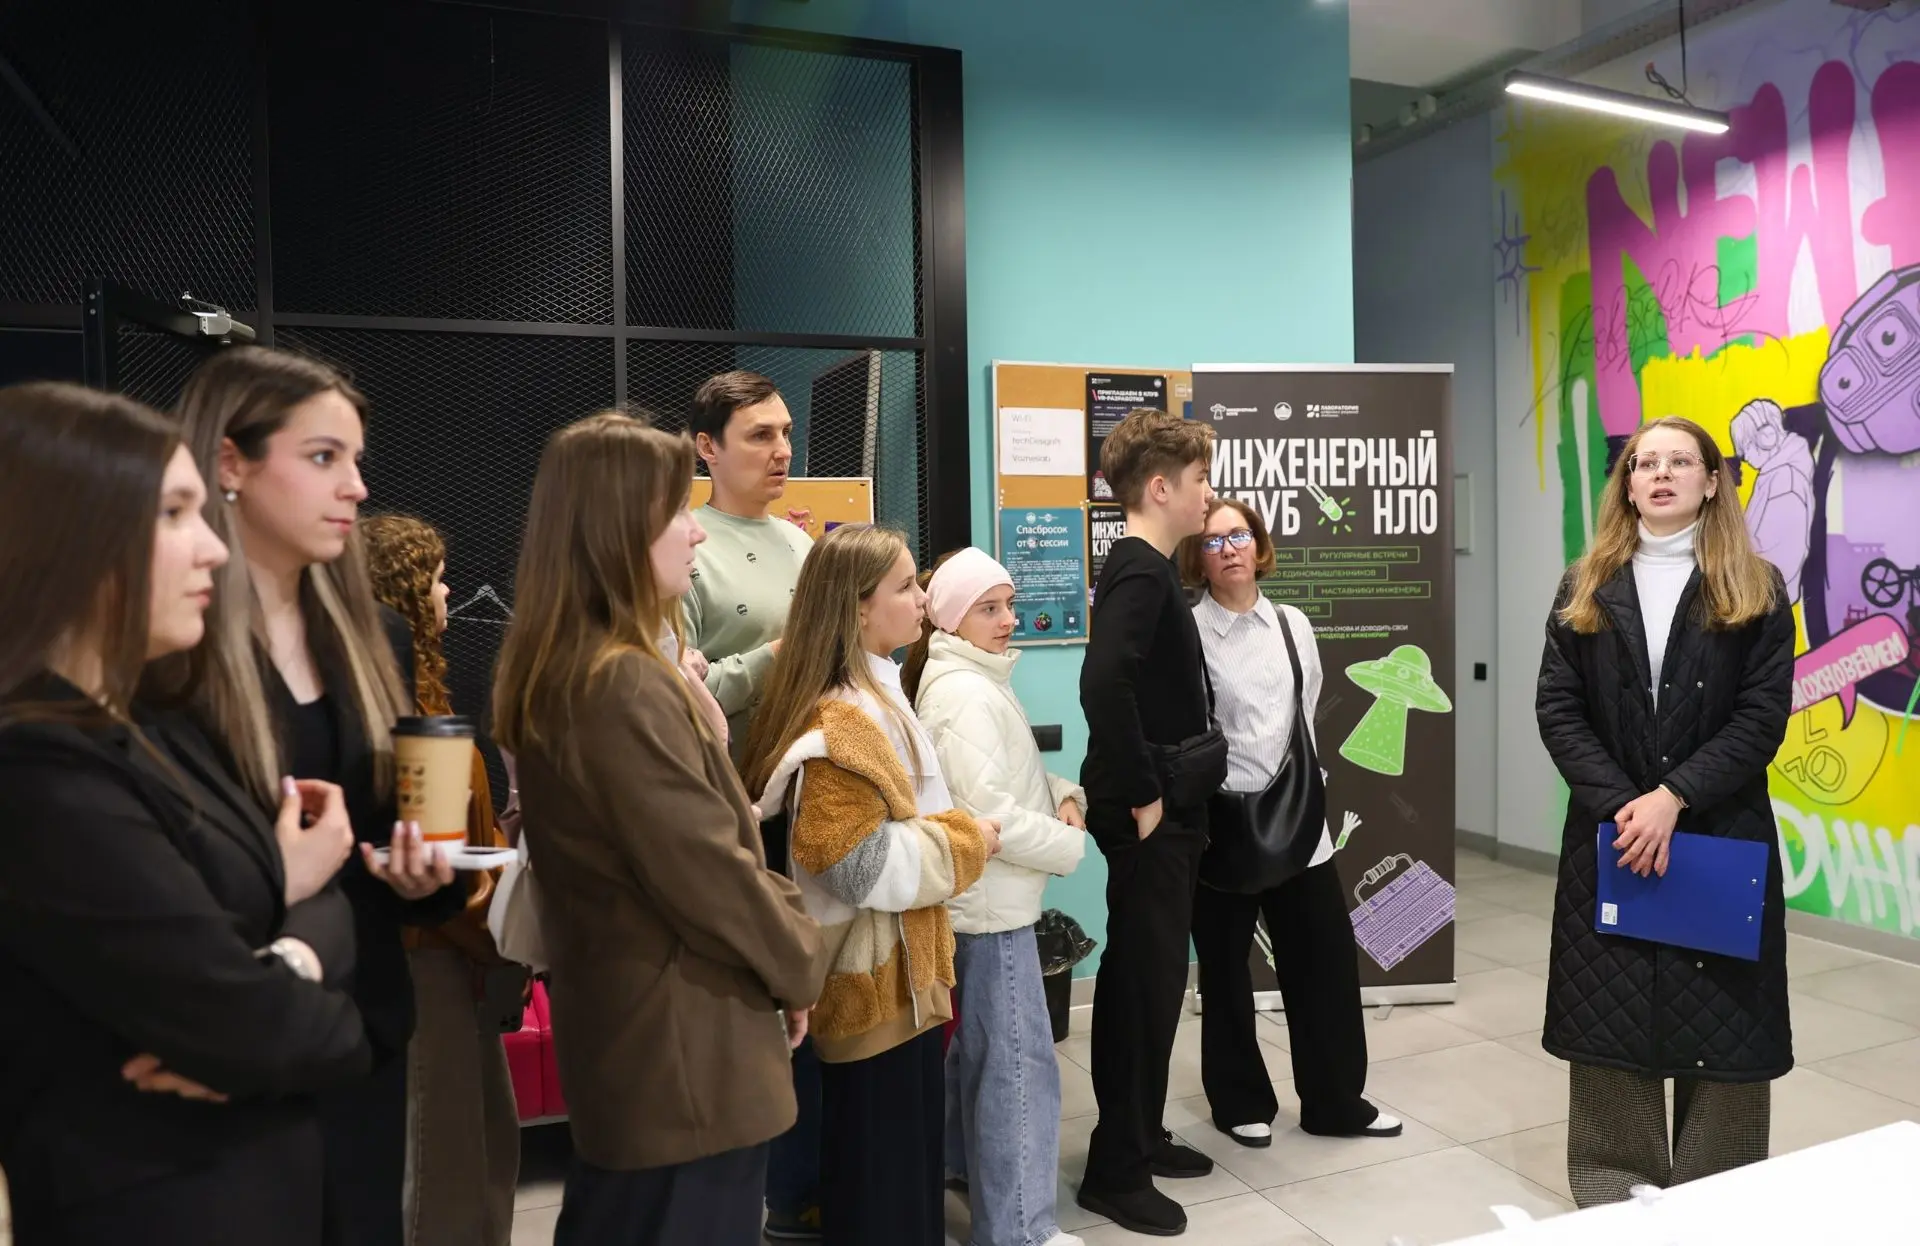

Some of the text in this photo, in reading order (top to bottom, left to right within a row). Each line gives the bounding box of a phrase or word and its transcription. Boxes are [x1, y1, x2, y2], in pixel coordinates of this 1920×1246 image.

[1211, 430, 1438, 488] ИНЖЕНЕРНЫЙ
[1214, 488, 1438, 536] УБ НЛО
[1016, 525, 1068, 536] Спасбросок
[1040, 539, 1069, 547] сессии
[1373, 551, 1408, 559] ВСТРЕЧИ
[1282, 569, 1376, 579] ЕДИНОМЫШЛЕННИКОВ
[1321, 586, 1421, 595] НАСТАВНИКИ ИНЖЕНЕРЫ
[1300, 605, 1321, 613] АТИВ
[1791, 631, 1908, 708] ДОХНОВЕНИЕМ
